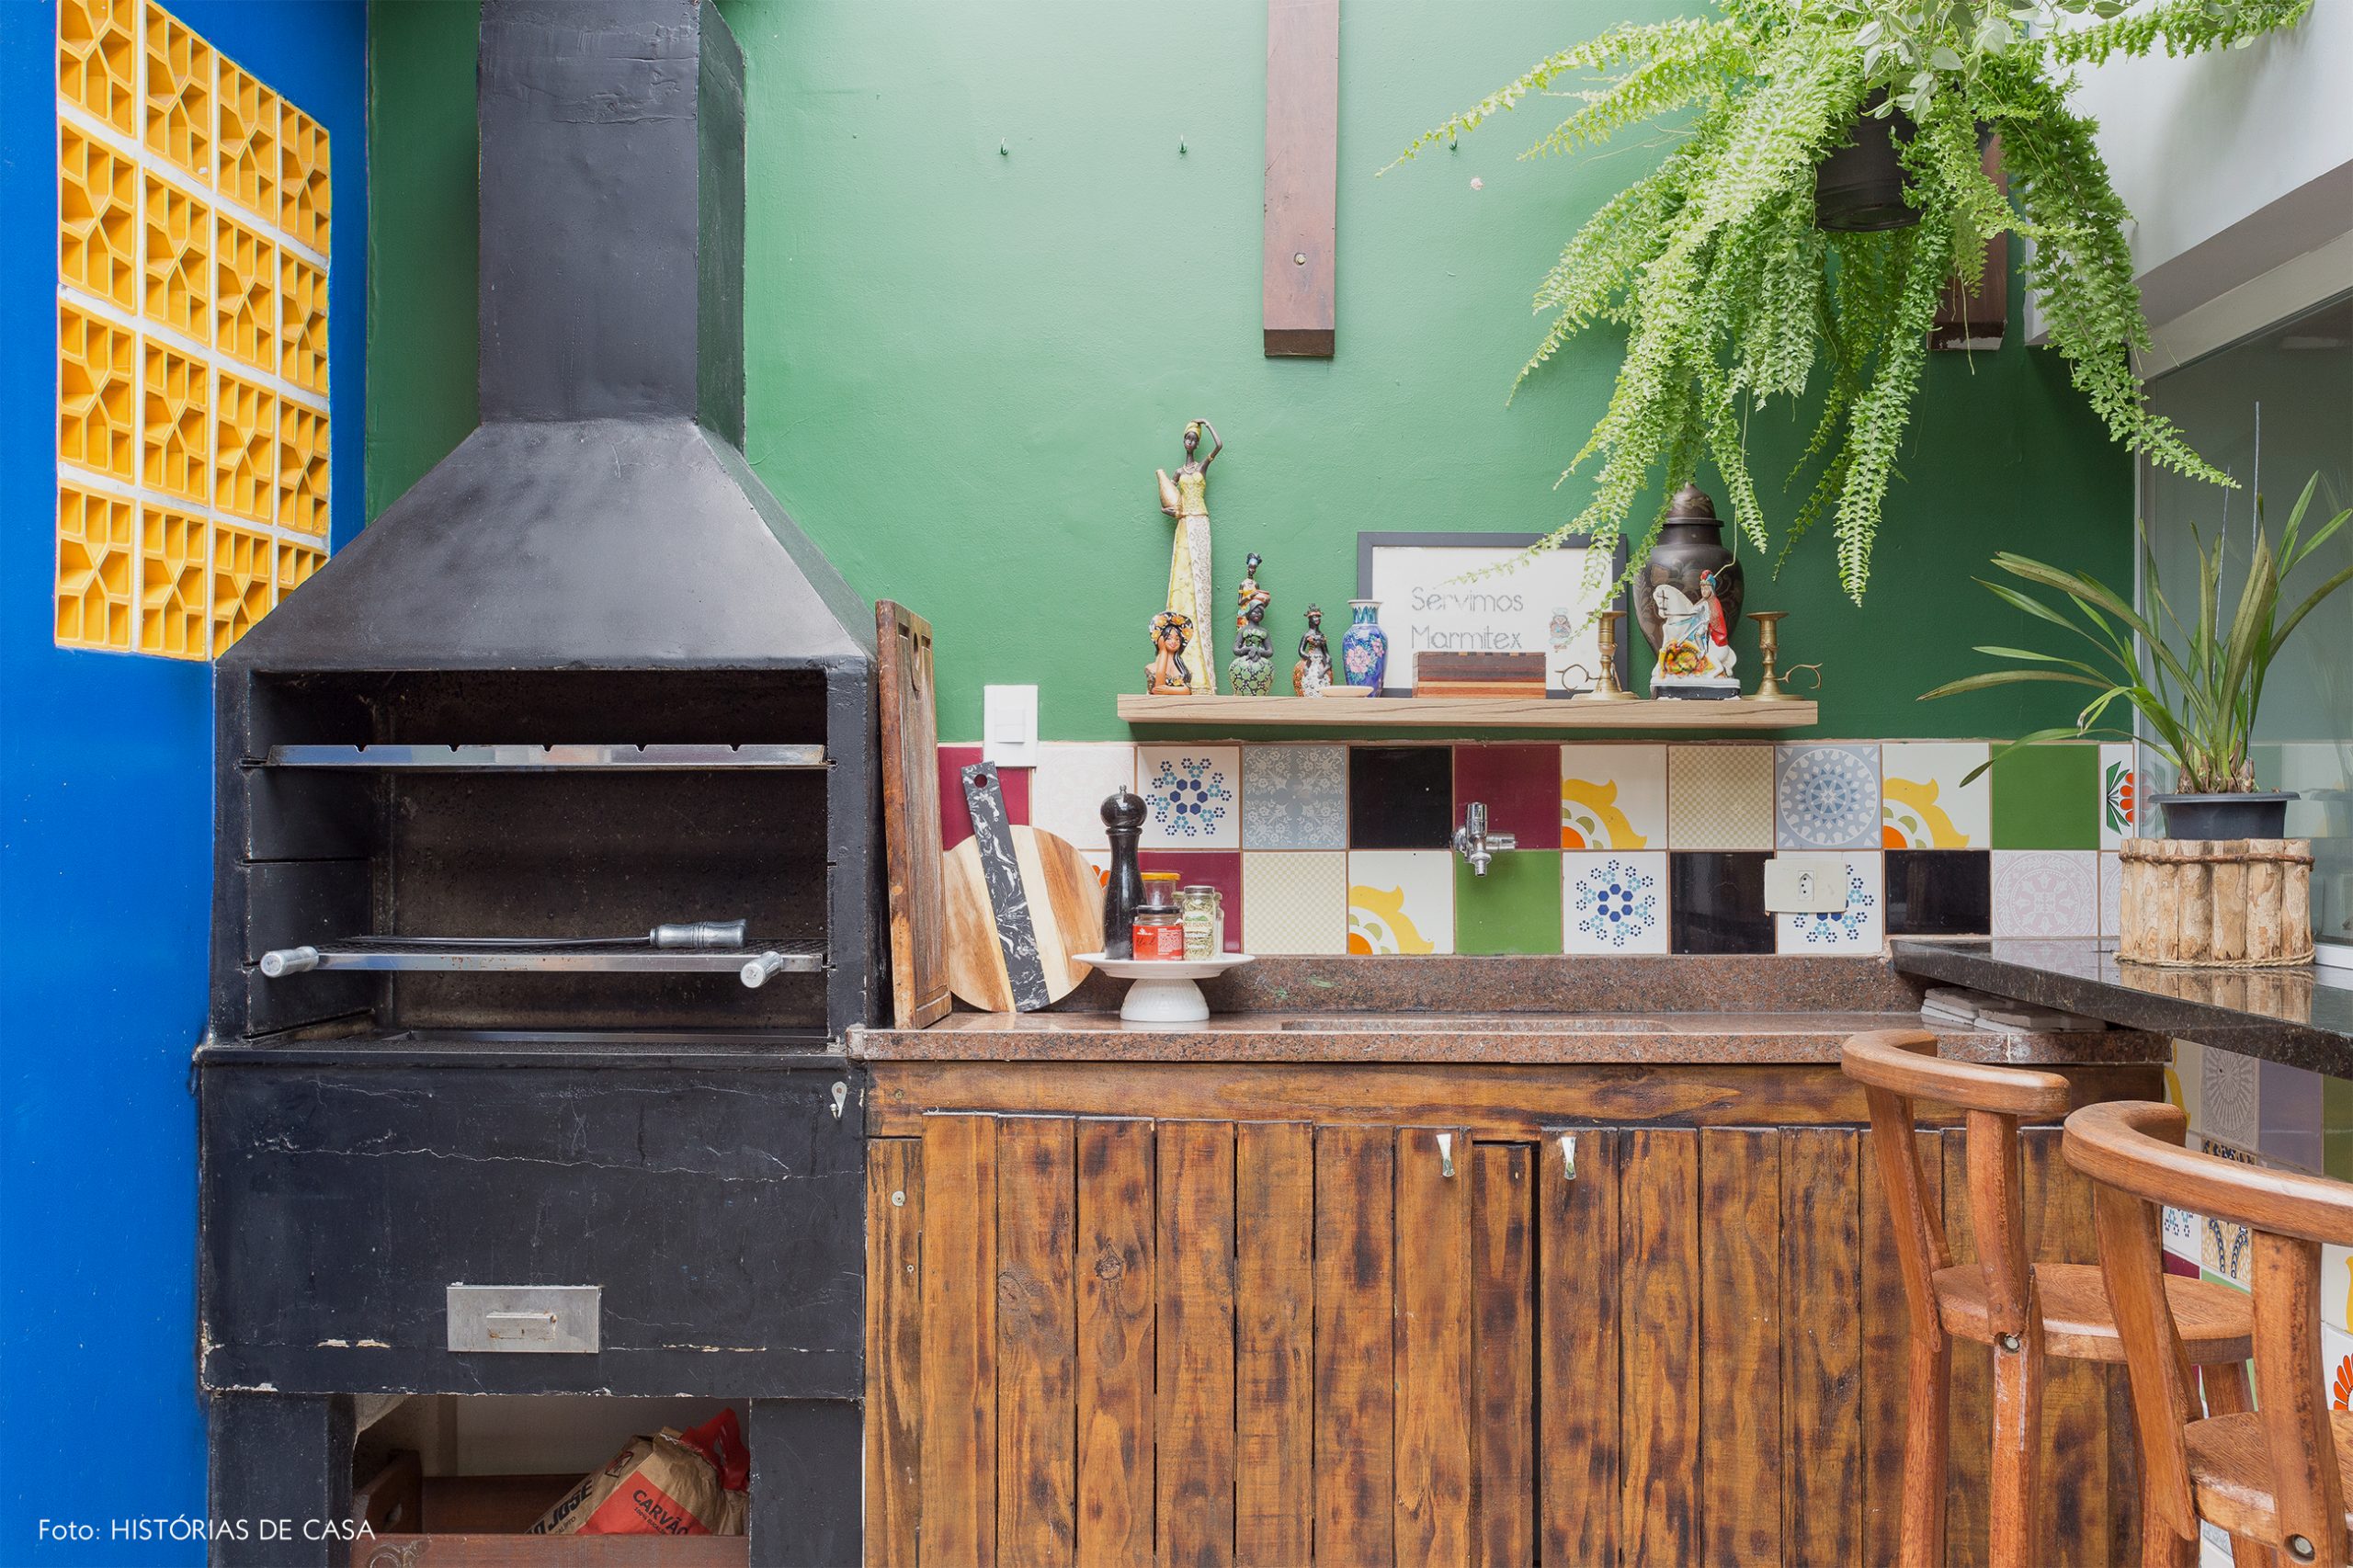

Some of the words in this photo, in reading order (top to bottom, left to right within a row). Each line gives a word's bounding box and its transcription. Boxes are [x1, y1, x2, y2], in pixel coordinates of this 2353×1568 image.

[1411, 586, 1524, 612] Servimos
[1411, 624, 1523, 650] Marmitex
[632, 1489, 688, 1535] CARVÃO
